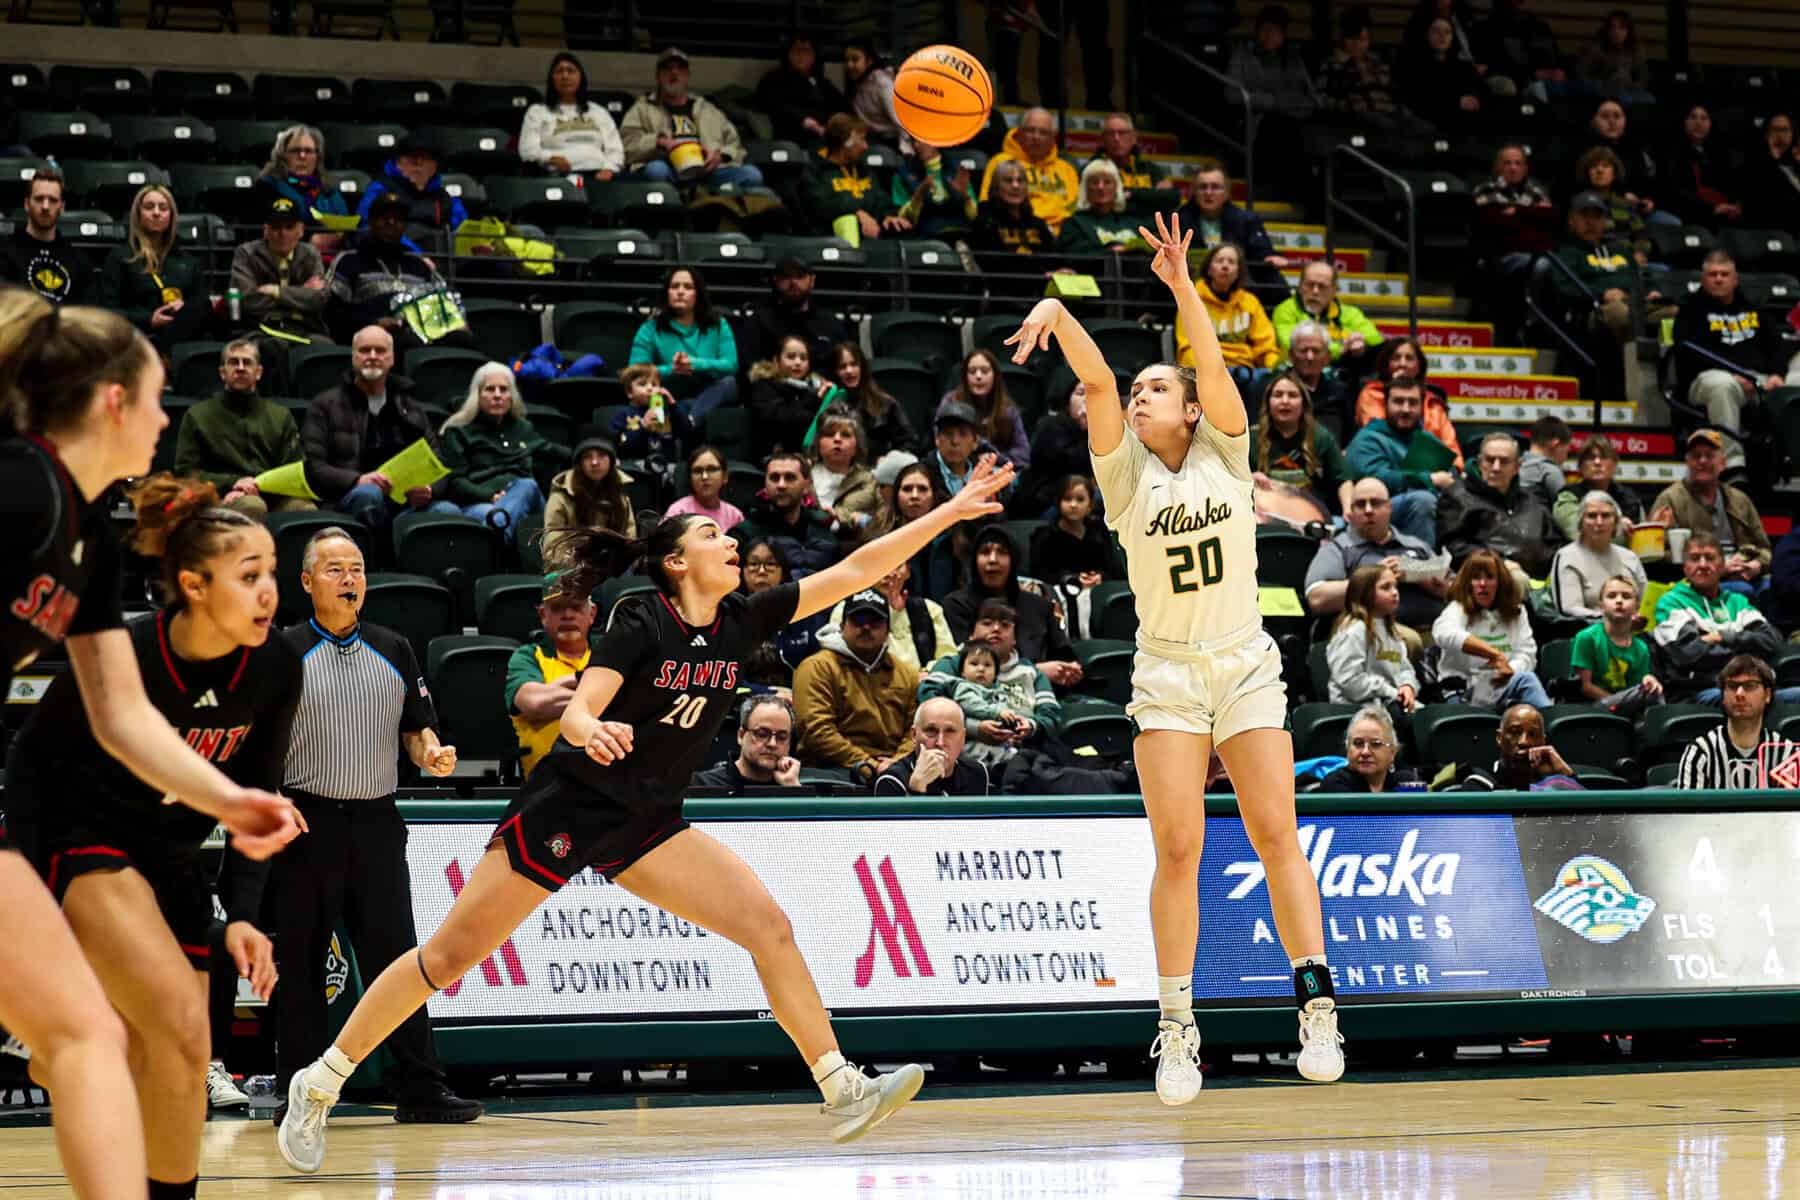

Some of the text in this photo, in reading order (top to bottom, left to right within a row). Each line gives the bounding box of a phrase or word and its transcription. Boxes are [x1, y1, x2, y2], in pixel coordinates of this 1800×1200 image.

[1459, 383, 1513, 398] Powered
[1513, 385, 1529, 401] by
[1145, 496, 1232, 537] Alaska
[1165, 536, 1224, 594] 20
[658, 693, 708, 729] 20
[935, 850, 1064, 881] MARRIOTT
[946, 900, 1103, 932] ANCHORAGE
[1663, 903, 1776, 941] FLS 1
[549, 960, 713, 995] DOWNTOWN
[954, 951, 1109, 985] DOWNTOWN
[1666, 945, 1785, 981] TOL 4
[1520, 988, 1587, 999] DAKTRONICS
